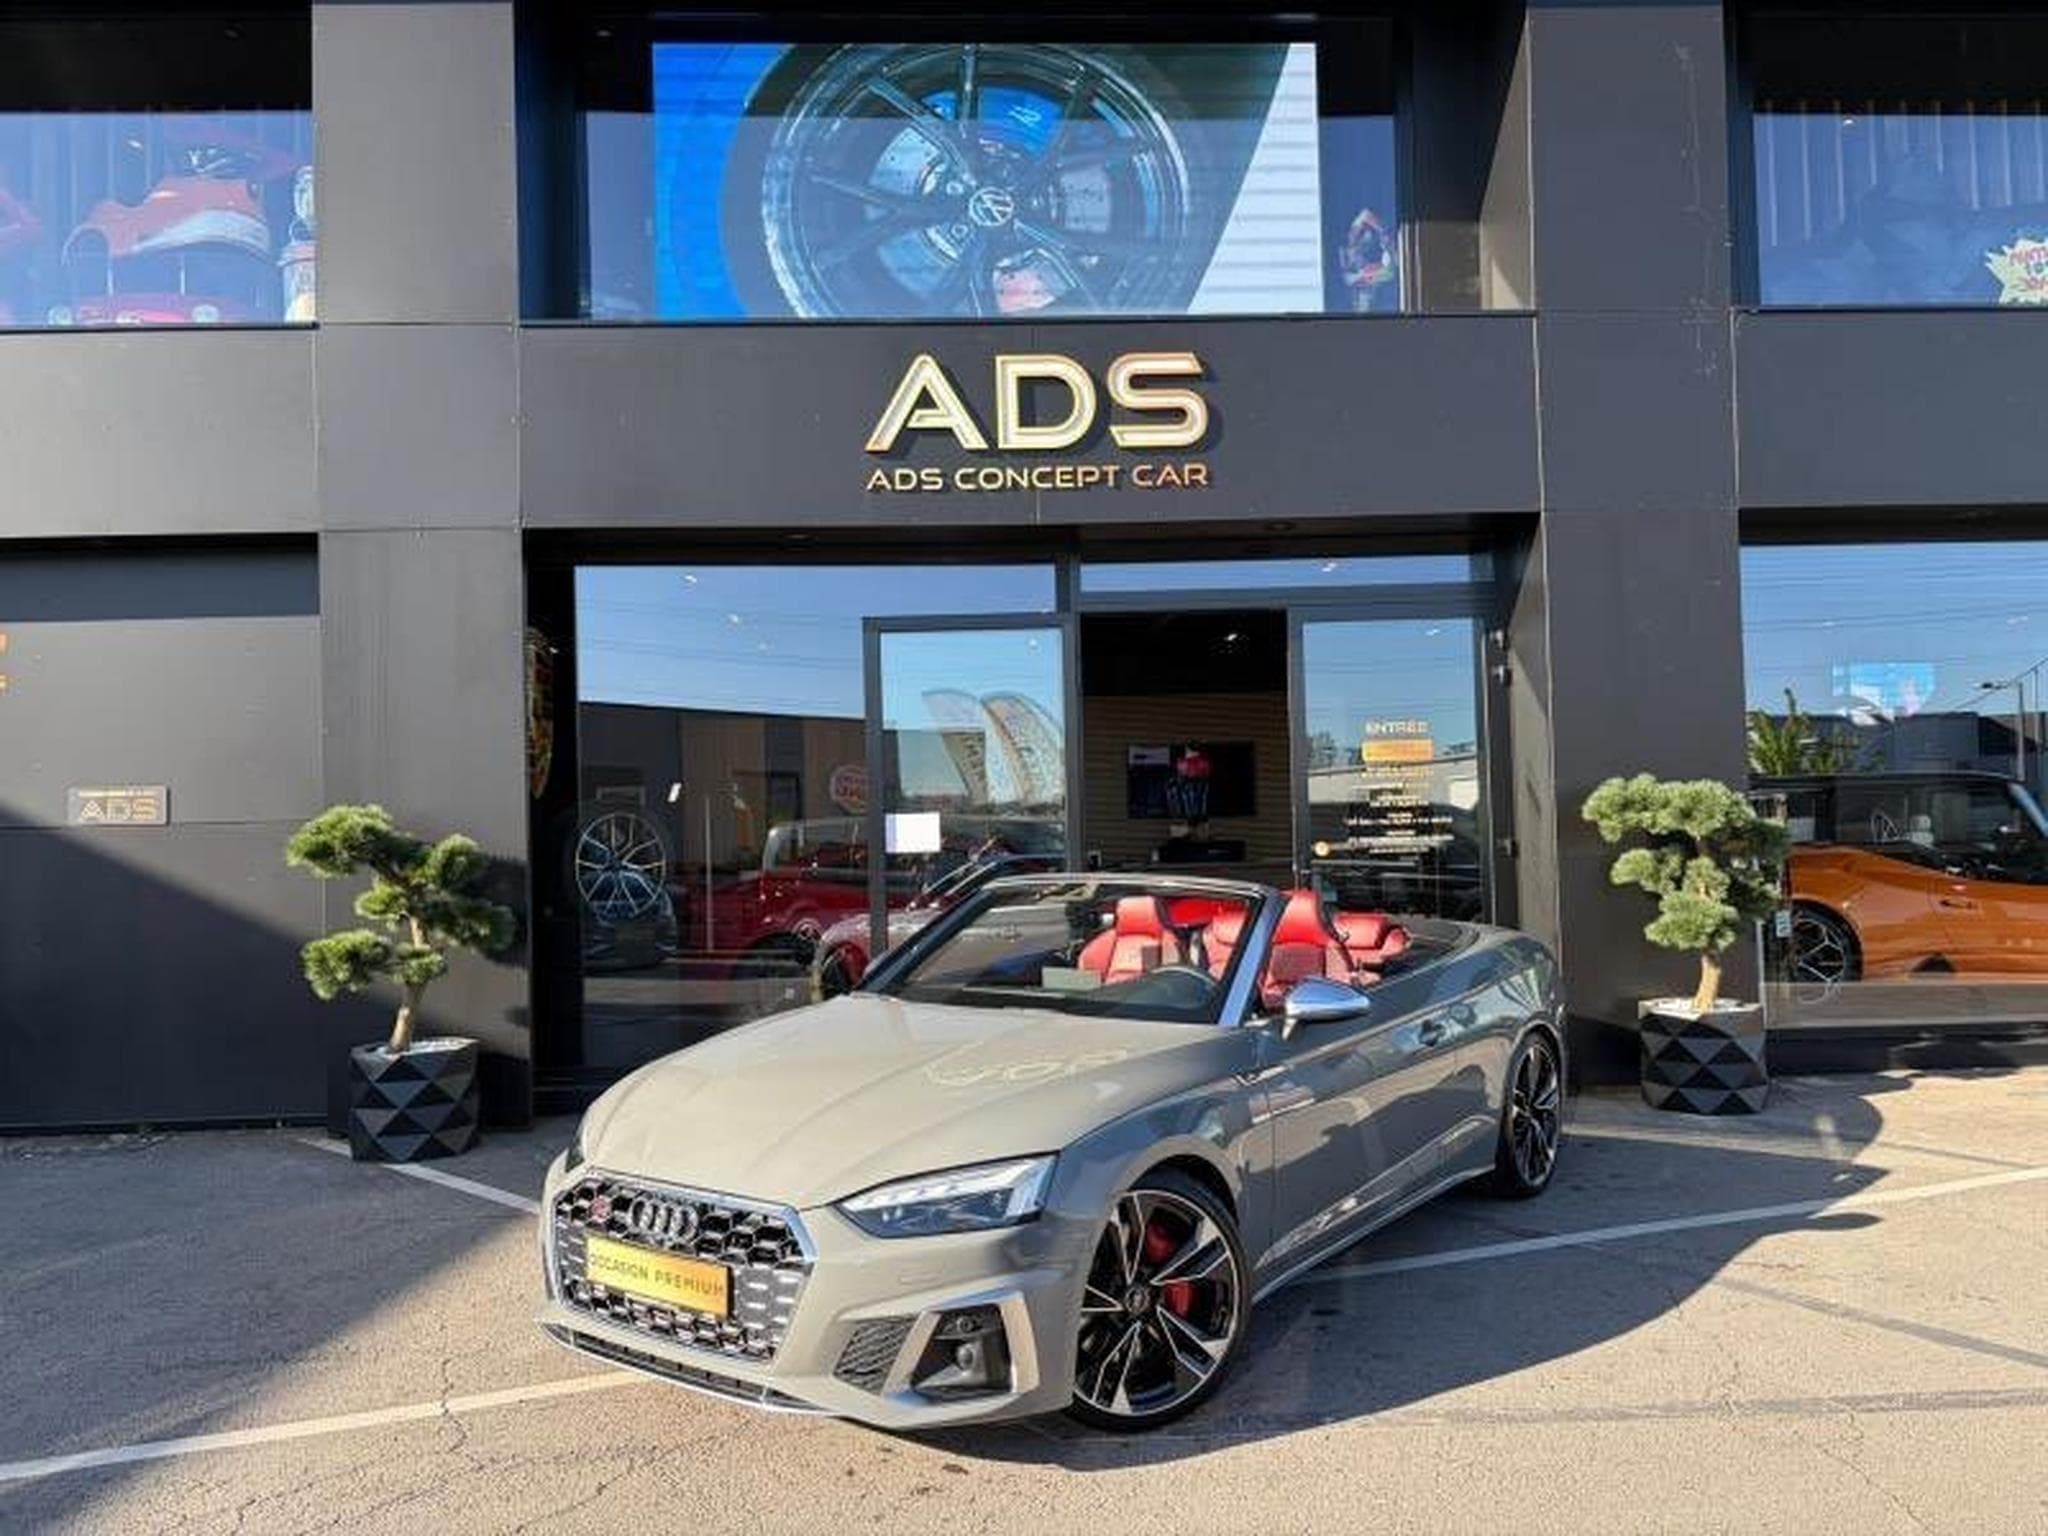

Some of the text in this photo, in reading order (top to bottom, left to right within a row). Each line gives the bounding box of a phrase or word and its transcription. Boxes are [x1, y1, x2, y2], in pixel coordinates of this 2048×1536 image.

[864, 352, 1209, 453] ADS
[867, 463, 1208, 490] ADS CONCEPT CAR
[79, 799, 157, 821] ADS
[654, 1268, 725, 1297] PREMIUM
